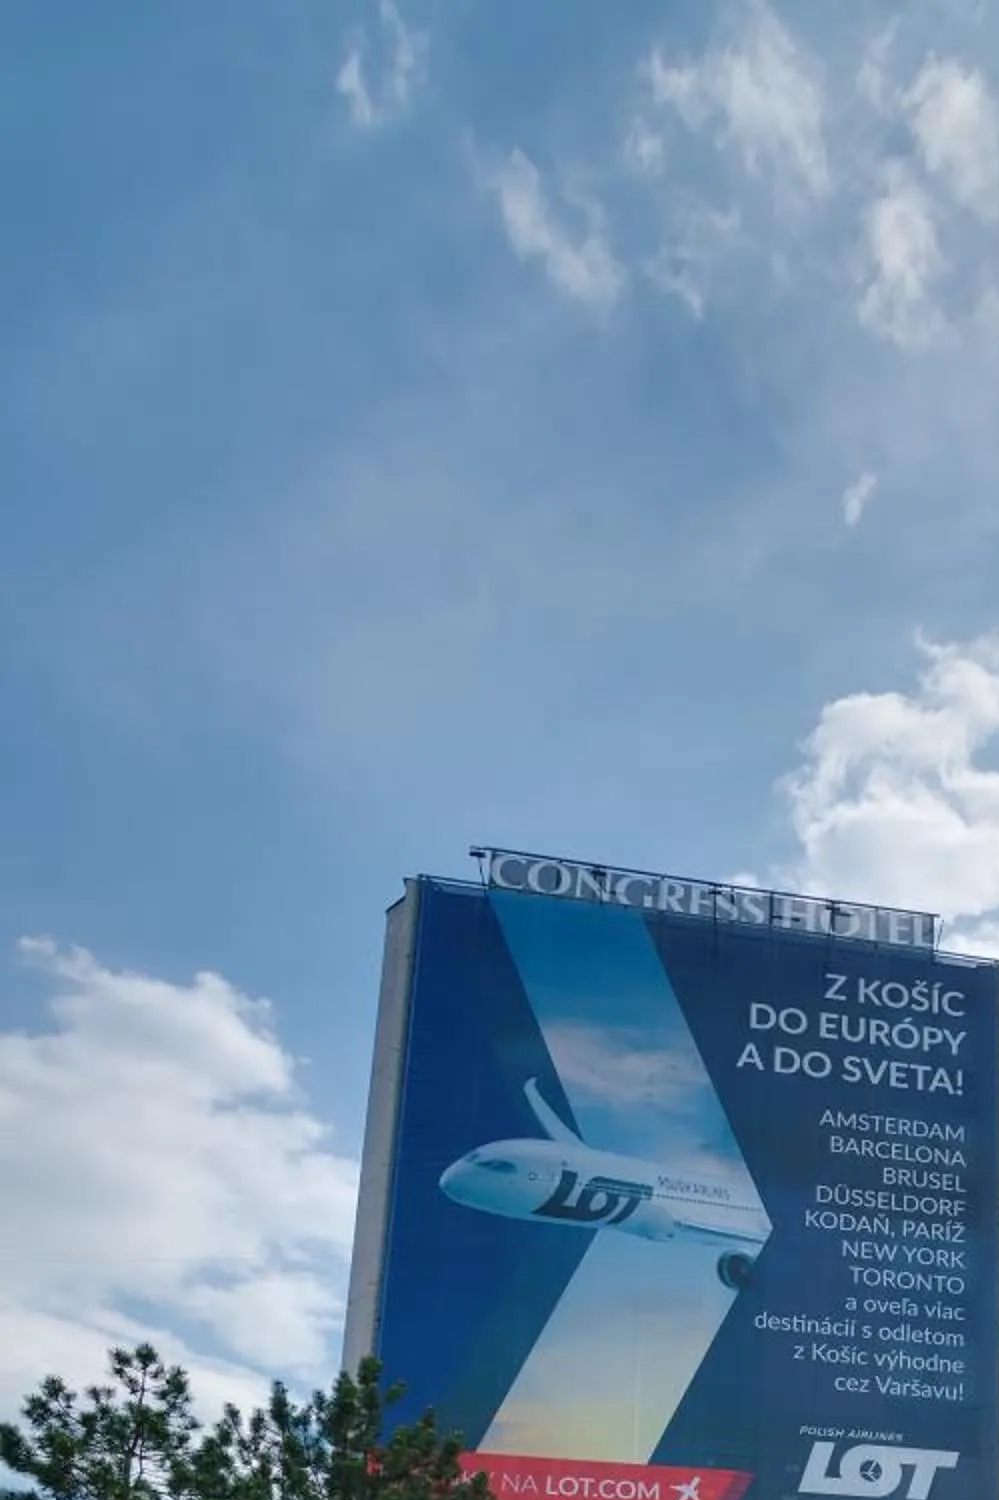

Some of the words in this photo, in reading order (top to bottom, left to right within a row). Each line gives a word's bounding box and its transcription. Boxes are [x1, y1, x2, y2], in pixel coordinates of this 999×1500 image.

[490, 853, 765, 925] CONGRESS
[780, 898, 935, 947] HOTEL
[824, 973, 847, 1000] Z
[858, 978, 966, 1016] KOŠÍC
[750, 1003, 808, 1034] DO
[819, 1012, 966, 1056] EURÓPY
[736, 1043, 765, 1070] A
[774, 1047, 832, 1078] DO
[842, 1056, 963, 1095] SVETA!
[819, 1110, 966, 1142] AMSTERDAM
[830, 1136, 967, 1168] BARCELONA
[882, 1167, 967, 1192] BRUSEL
[530, 1169, 653, 1224] LOT
[816, 1184, 967, 1216] DÜSSELDORF
[804, 1210, 895, 1237] KODAŇ,
[903, 1219, 966, 1242] PARÍŽ
[842, 1240, 897, 1262] NEW
[903, 1245, 966, 1269] YORK
[849, 1266, 965, 1295] TORONTO
[845, 1297, 857, 1311] a
[863, 1297, 918, 1317] oveľa
[925, 1302, 965, 1321] viac
[754, 1312, 856, 1338] destinácií
[862, 1323, 873, 1339] s
[879, 1325, 965, 1347] odletom
[793, 1346, 804, 1360] z
[811, 1343, 868, 1365] Košíc
[873, 1350, 966, 1374] výhodne
[834, 1377, 869, 1393] cez
[875, 1375, 964, 1401] Varšavu!
[800, 1425, 845, 1438] POLISH
[501, 1473, 538, 1495] NA
[798, 1441, 960, 1500] LOT
